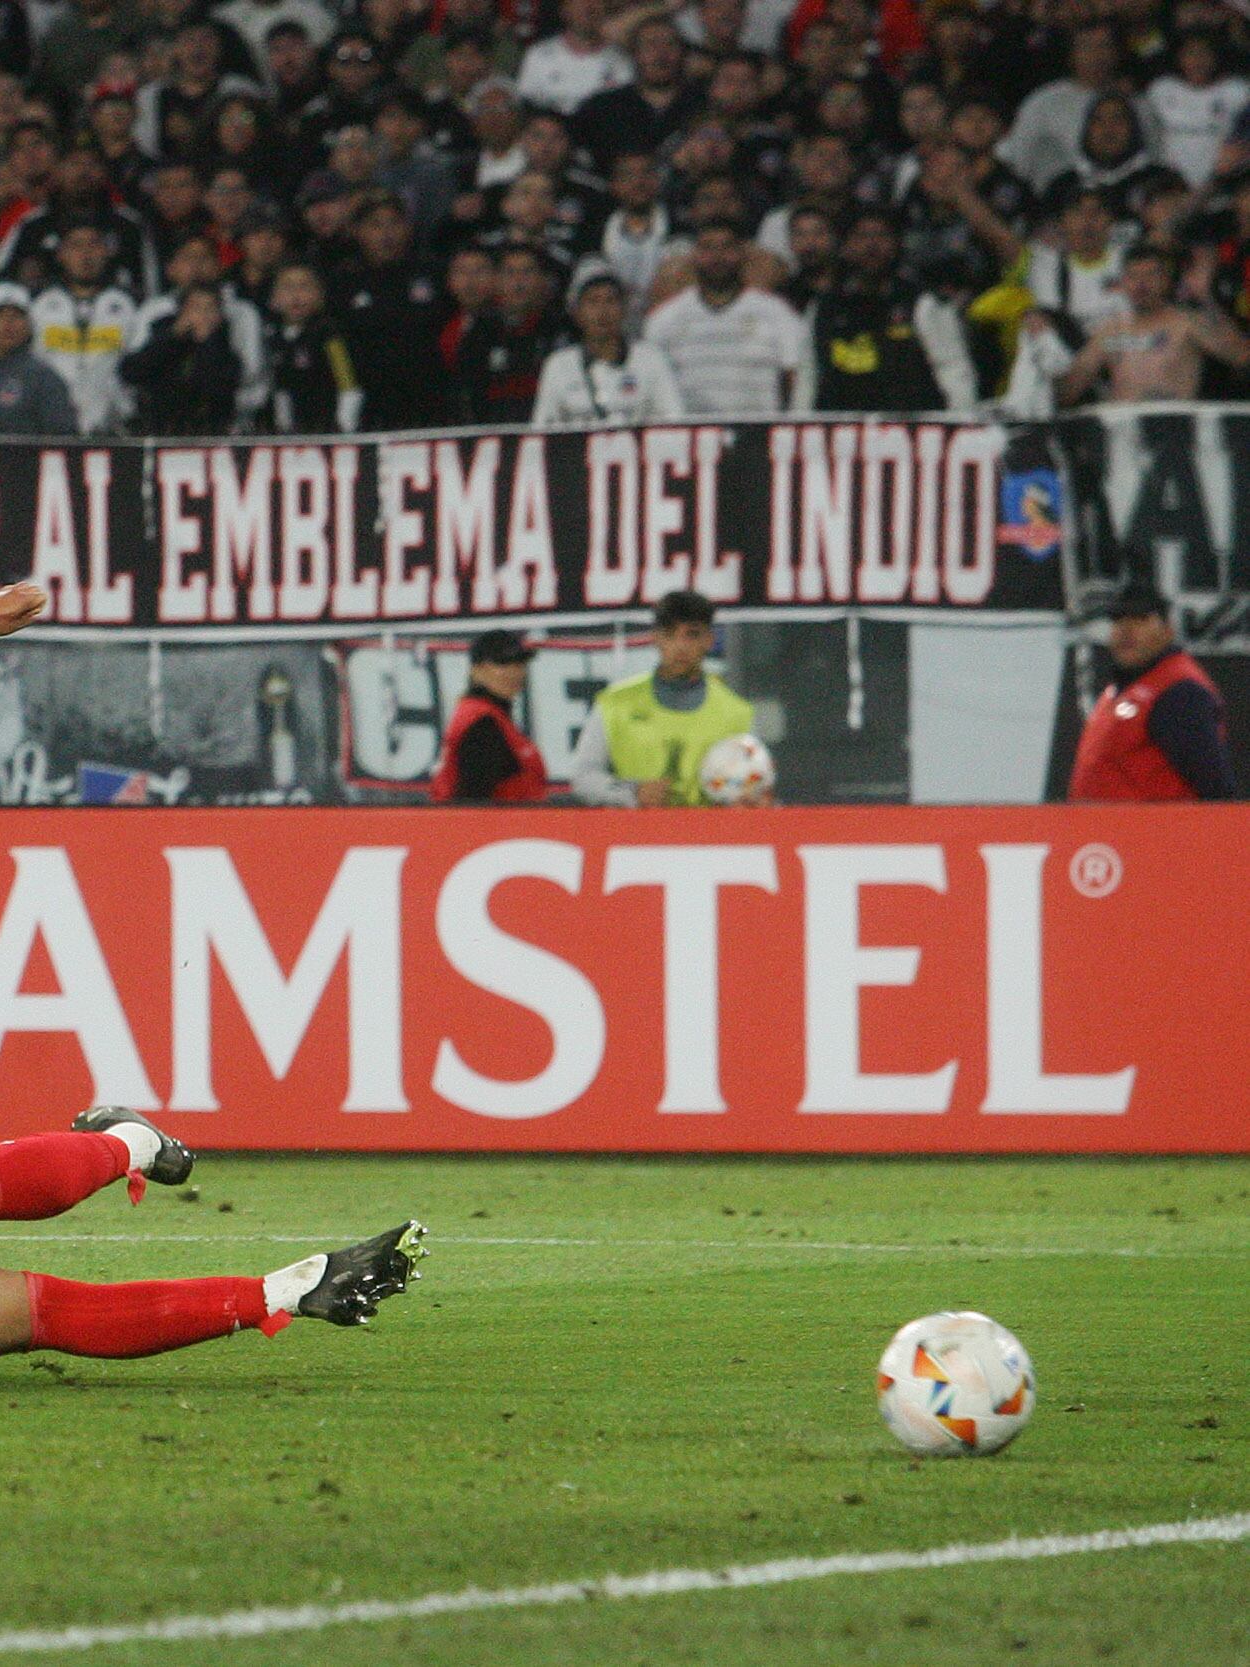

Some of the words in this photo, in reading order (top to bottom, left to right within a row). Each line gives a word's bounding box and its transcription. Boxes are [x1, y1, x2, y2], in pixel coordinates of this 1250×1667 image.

[30, 449, 134, 624] AL
[156, 435, 557, 623] EMBLEMA
[583, 425, 743, 606] DEL
[766, 422, 999, 606] INDIO
